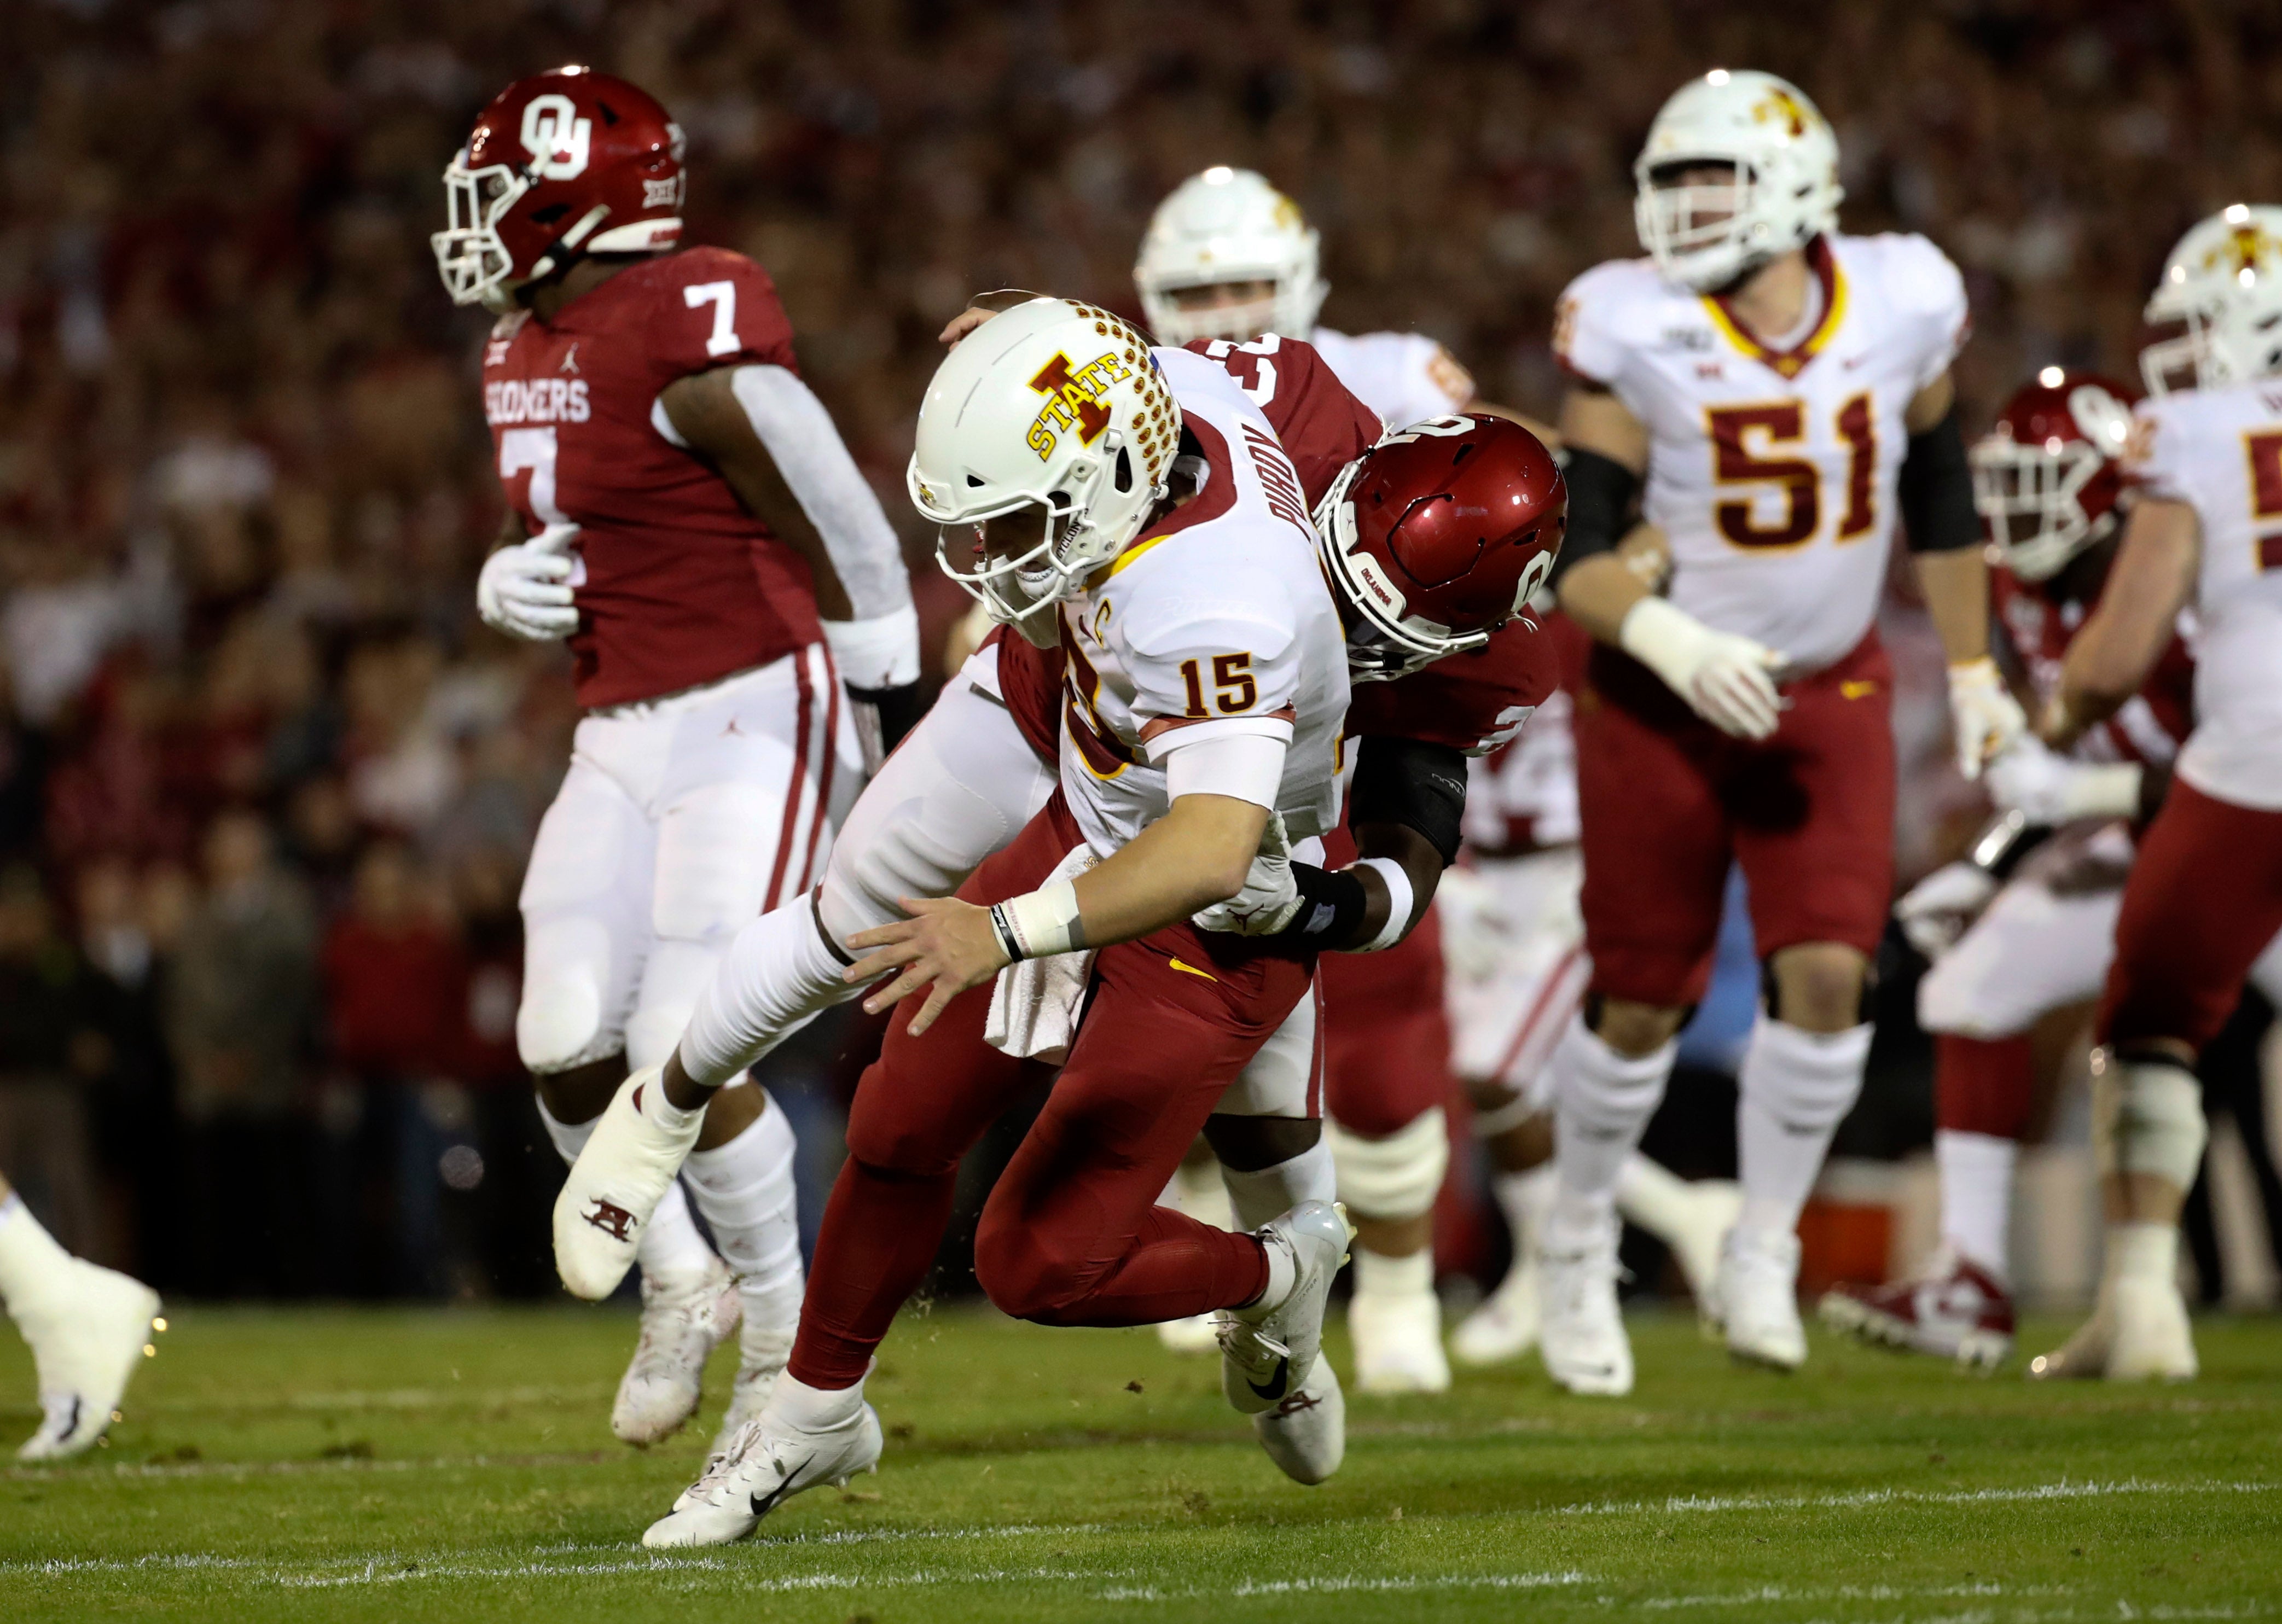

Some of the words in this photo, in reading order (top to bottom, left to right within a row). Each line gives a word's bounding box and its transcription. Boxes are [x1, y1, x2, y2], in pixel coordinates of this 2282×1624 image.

[520, 94, 593, 181] OU
[683, 280, 742, 357] 7
[1026, 352, 1133, 463] STATE
[500, 426, 587, 587] 7
[1240, 422, 1311, 545] PURDY
[1700, 390, 1877, 553] 51
[1179, 650, 1258, 719] 15
